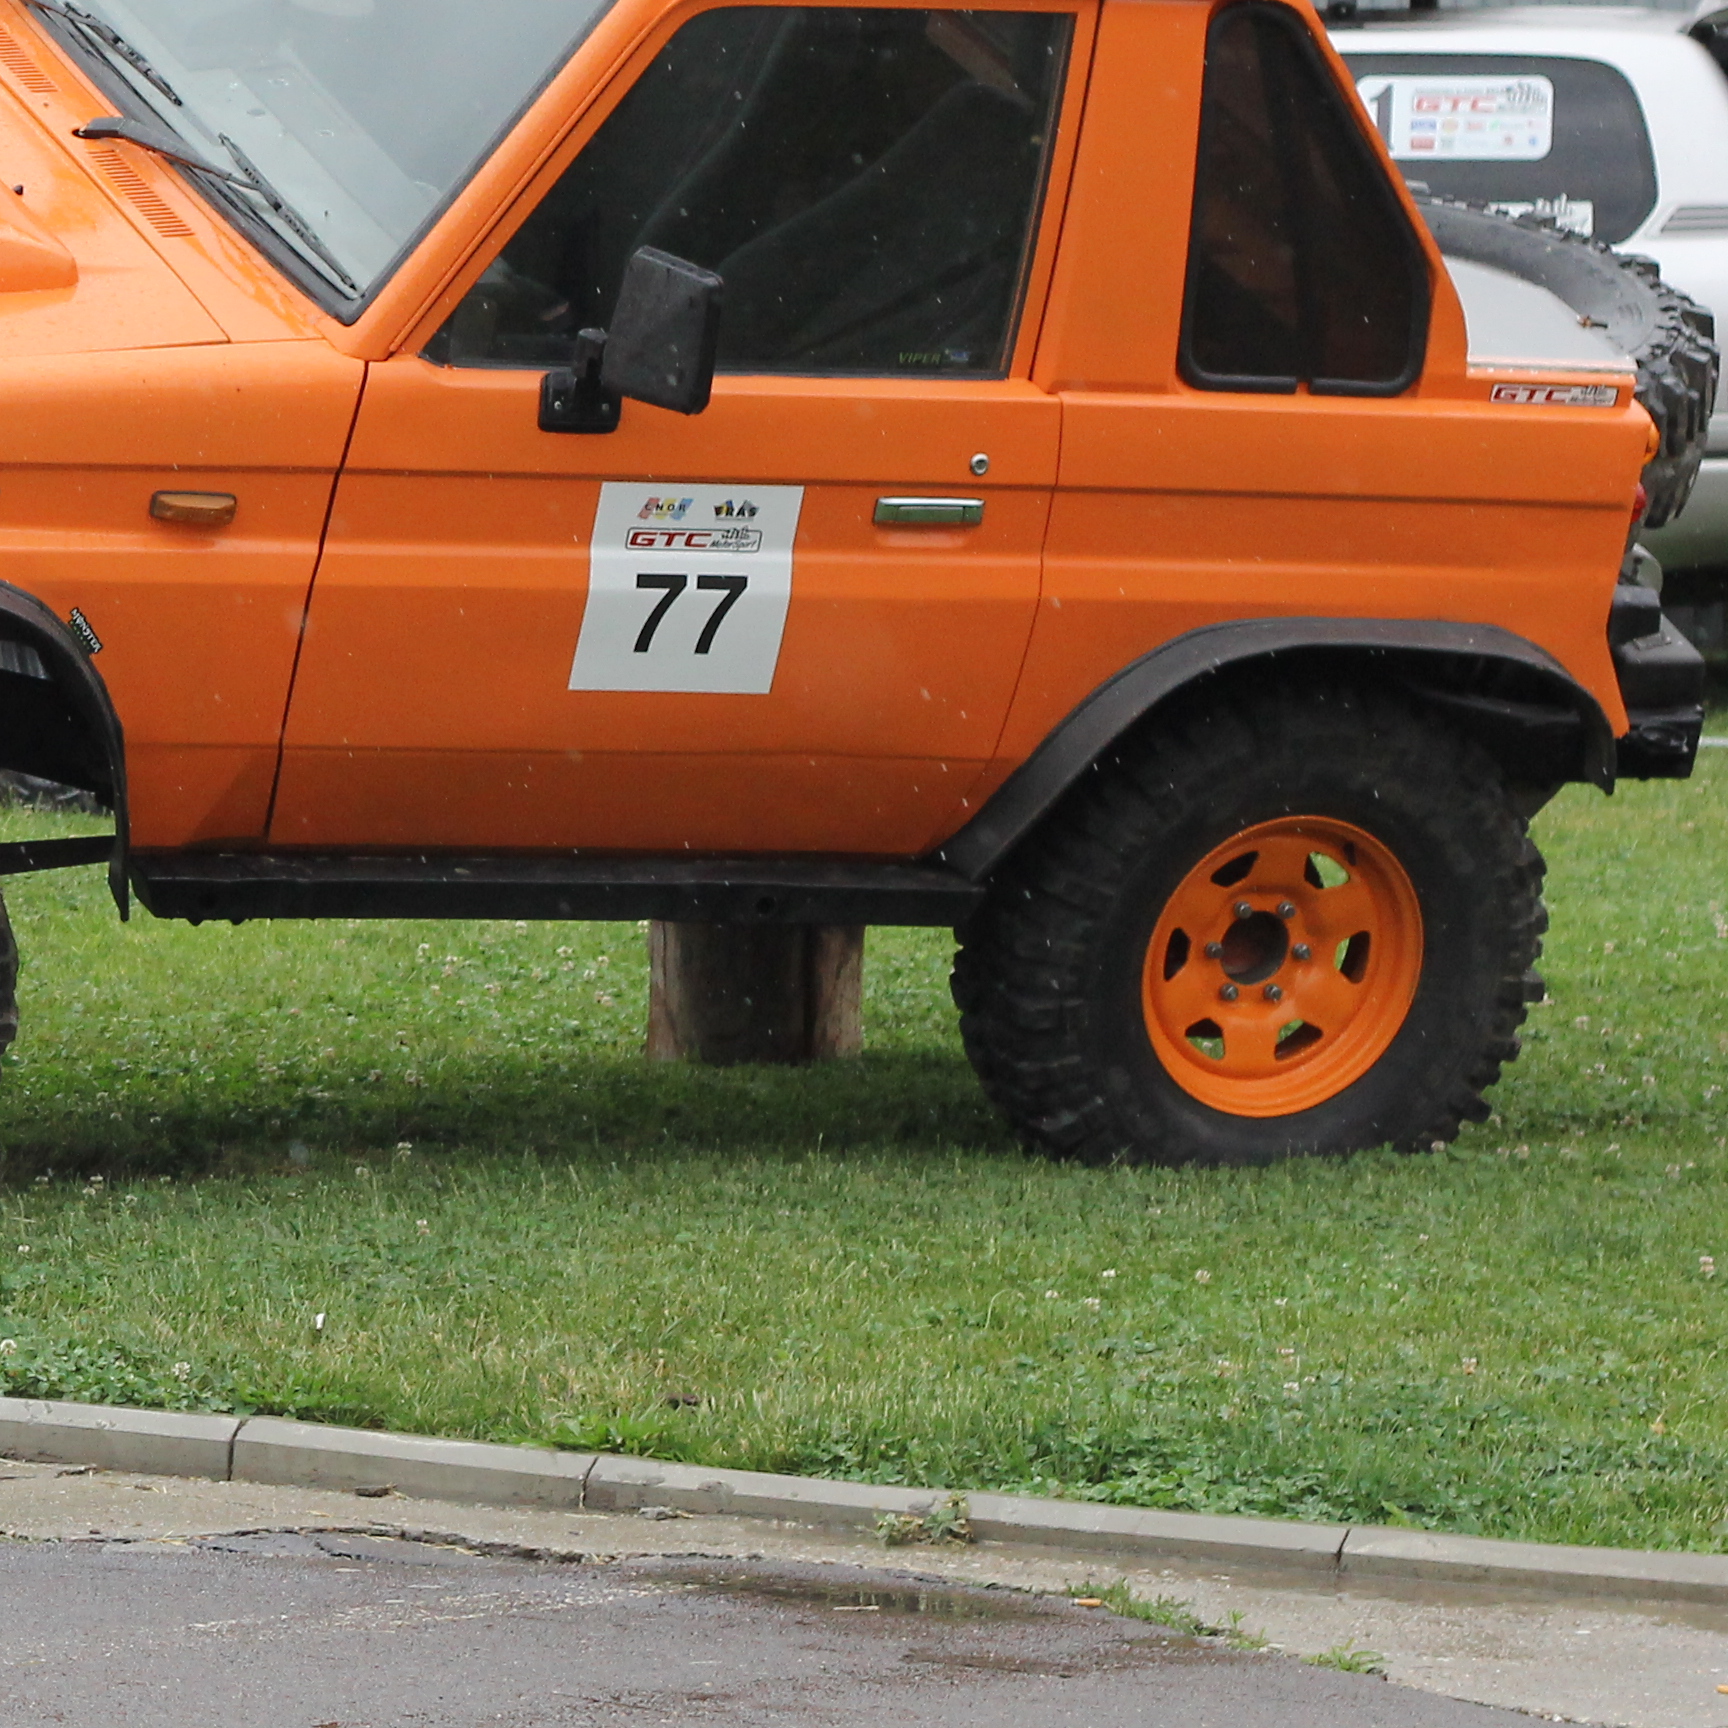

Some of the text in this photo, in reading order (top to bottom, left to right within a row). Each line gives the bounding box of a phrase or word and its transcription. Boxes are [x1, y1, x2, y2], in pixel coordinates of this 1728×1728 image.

[1493, 385, 1572, 404] GTC
[629, 531, 712, 548] GTC
[633, 573, 748, 654] 77
